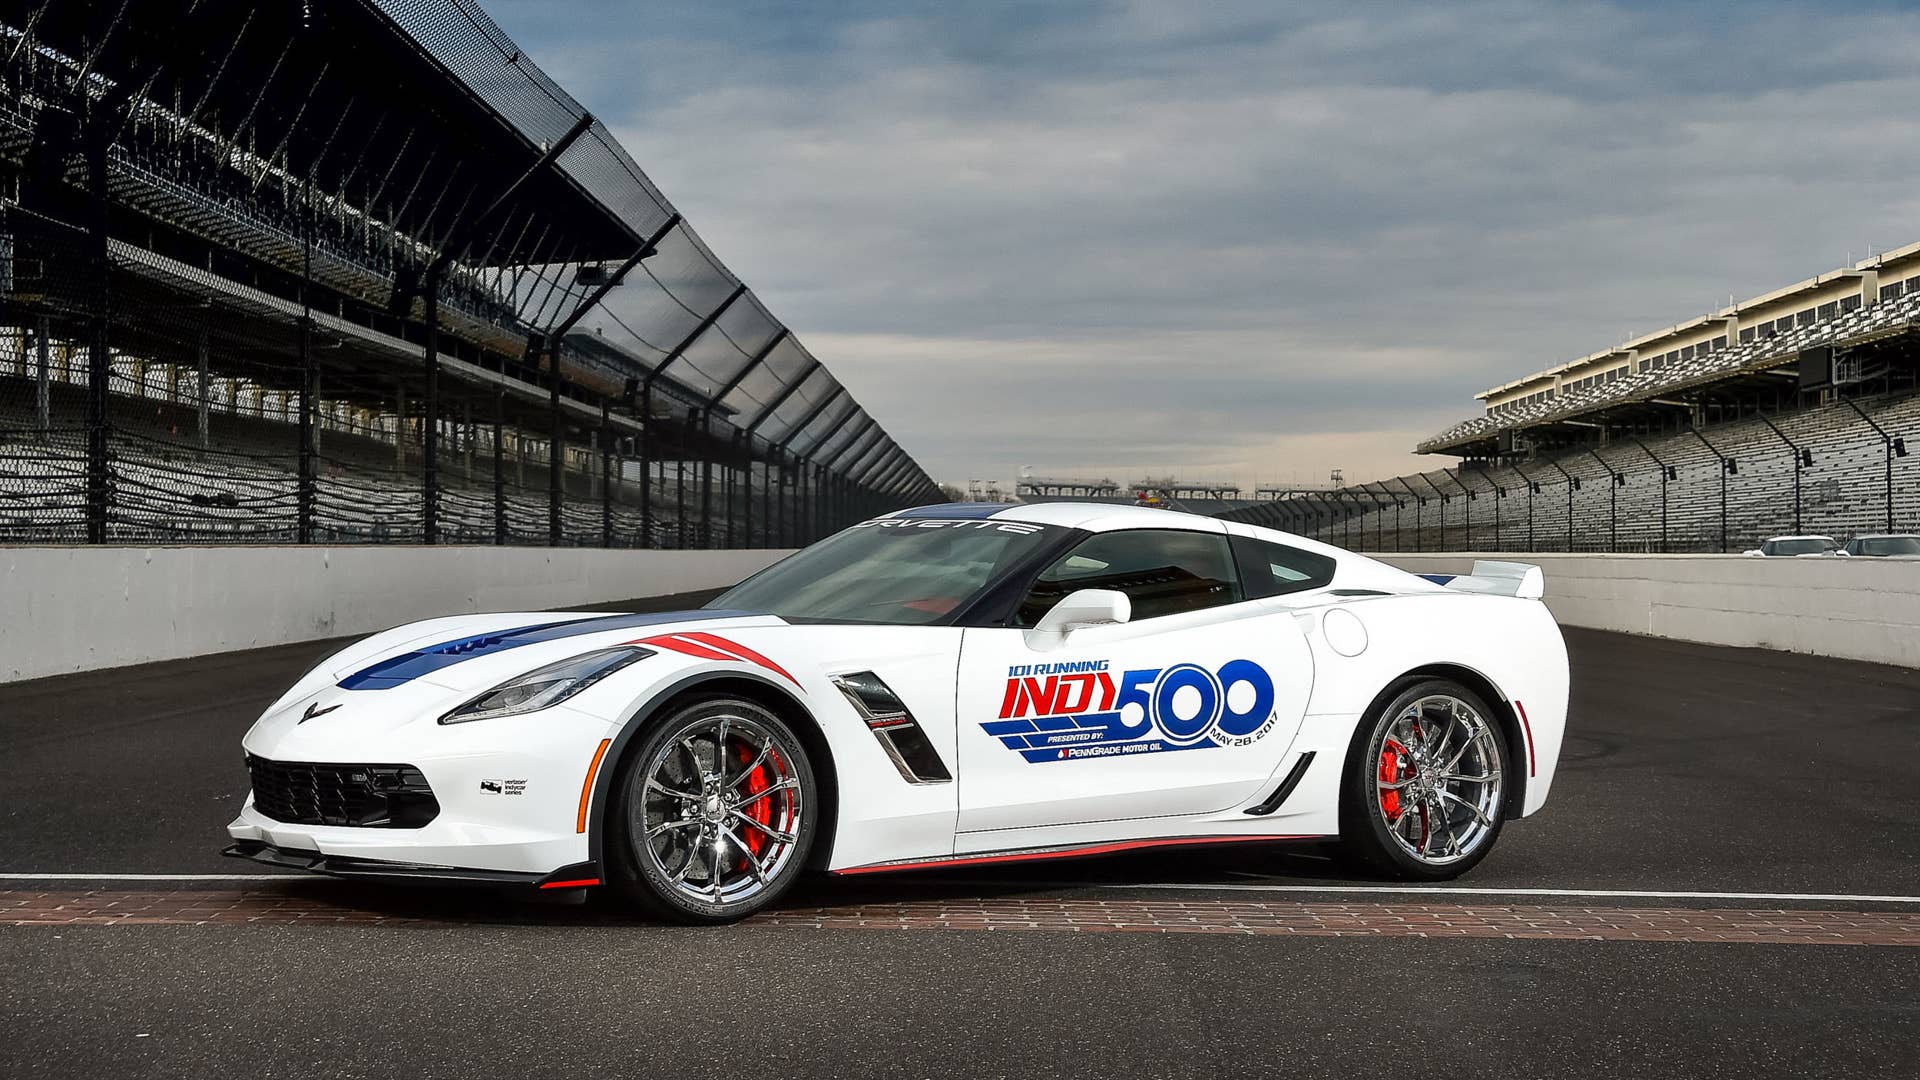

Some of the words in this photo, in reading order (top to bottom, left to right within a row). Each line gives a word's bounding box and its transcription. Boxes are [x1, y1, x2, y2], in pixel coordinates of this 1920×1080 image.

[852, 518, 1045, 535] ORVETTE
[1008, 665, 1031, 677] 101
[1034, 659, 1109, 675] RUNNING
[999, 672, 1116, 718] INDY
[1114, 659, 1275, 746] 500
[1209, 727, 1233, 746] MAY
[1255, 710, 1279, 740] 2017
[1047, 733, 1090, 743] PRESENTED
[1091, 732, 1104, 740] BY:
[1122, 744, 1148, 753] MOTOR
[1150, 743, 1162, 751] OIL
